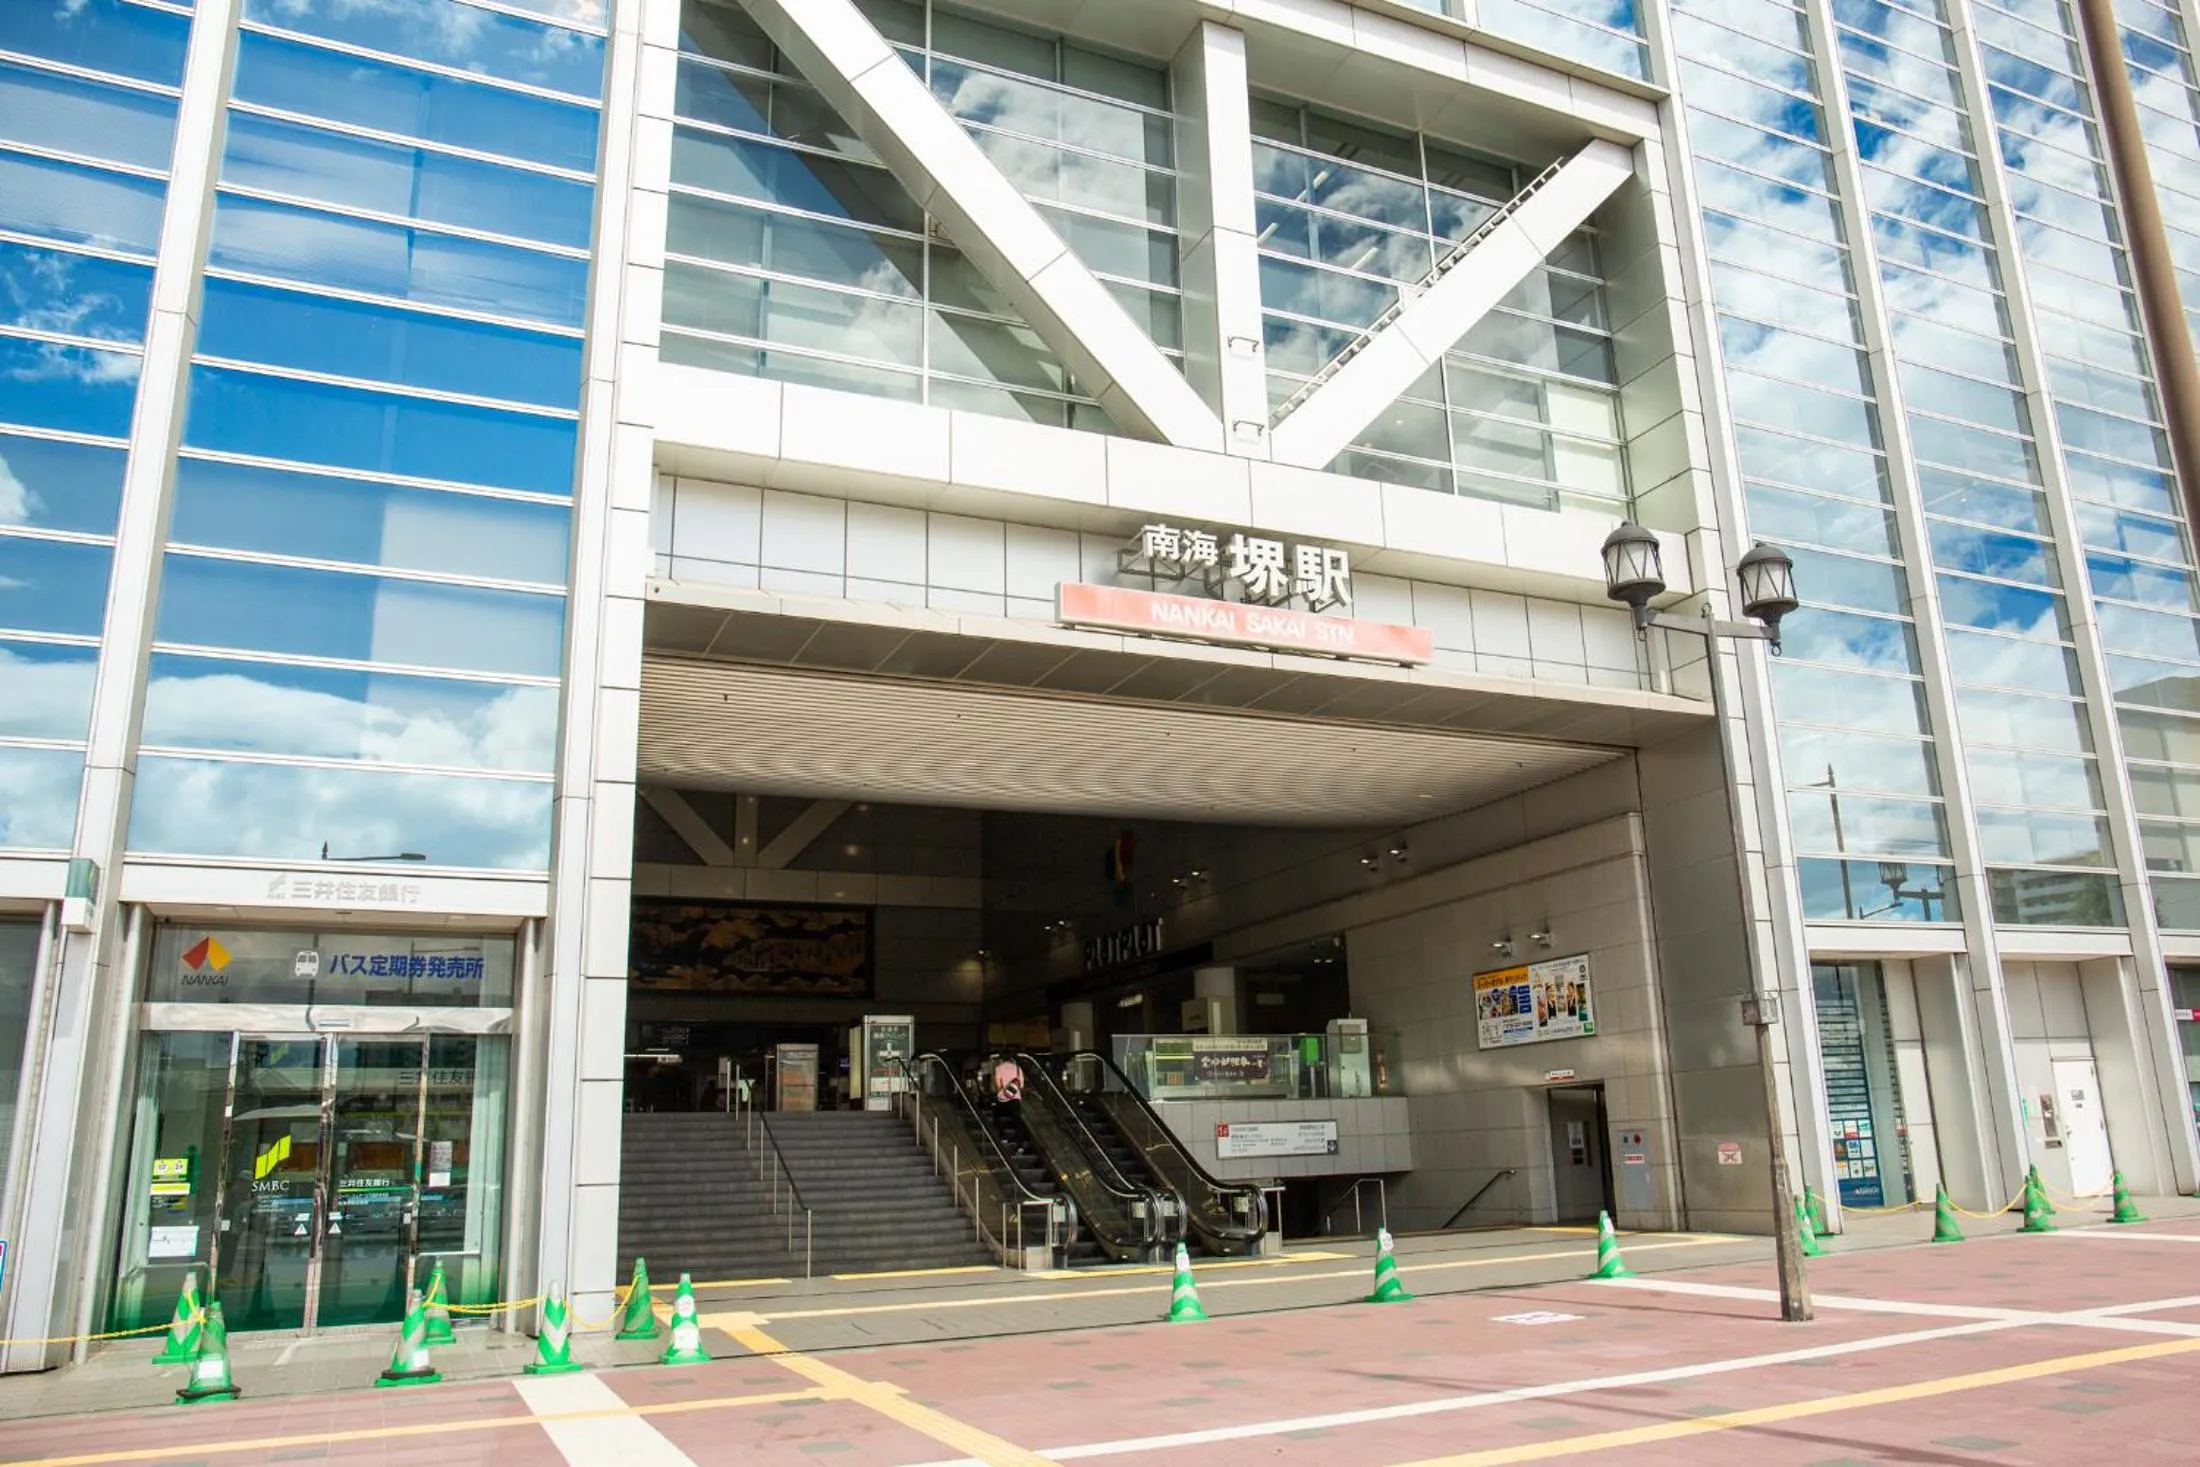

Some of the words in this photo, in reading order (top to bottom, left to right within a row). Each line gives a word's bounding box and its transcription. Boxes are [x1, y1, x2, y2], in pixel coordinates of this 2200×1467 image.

[1142, 523, 1218, 567] 南海
[1228, 533, 1353, 608] 堺駅
[1150, 600, 1236, 632] NANKAI
[1245, 612, 1306, 640] SAKAI
[291, 881, 420, 904] 三井住友銀行
[329, 953, 484, 979] バス定期券発売所
[181, 975, 230, 987] NANKAI
[251, 1180, 290, 1192] SMBC
